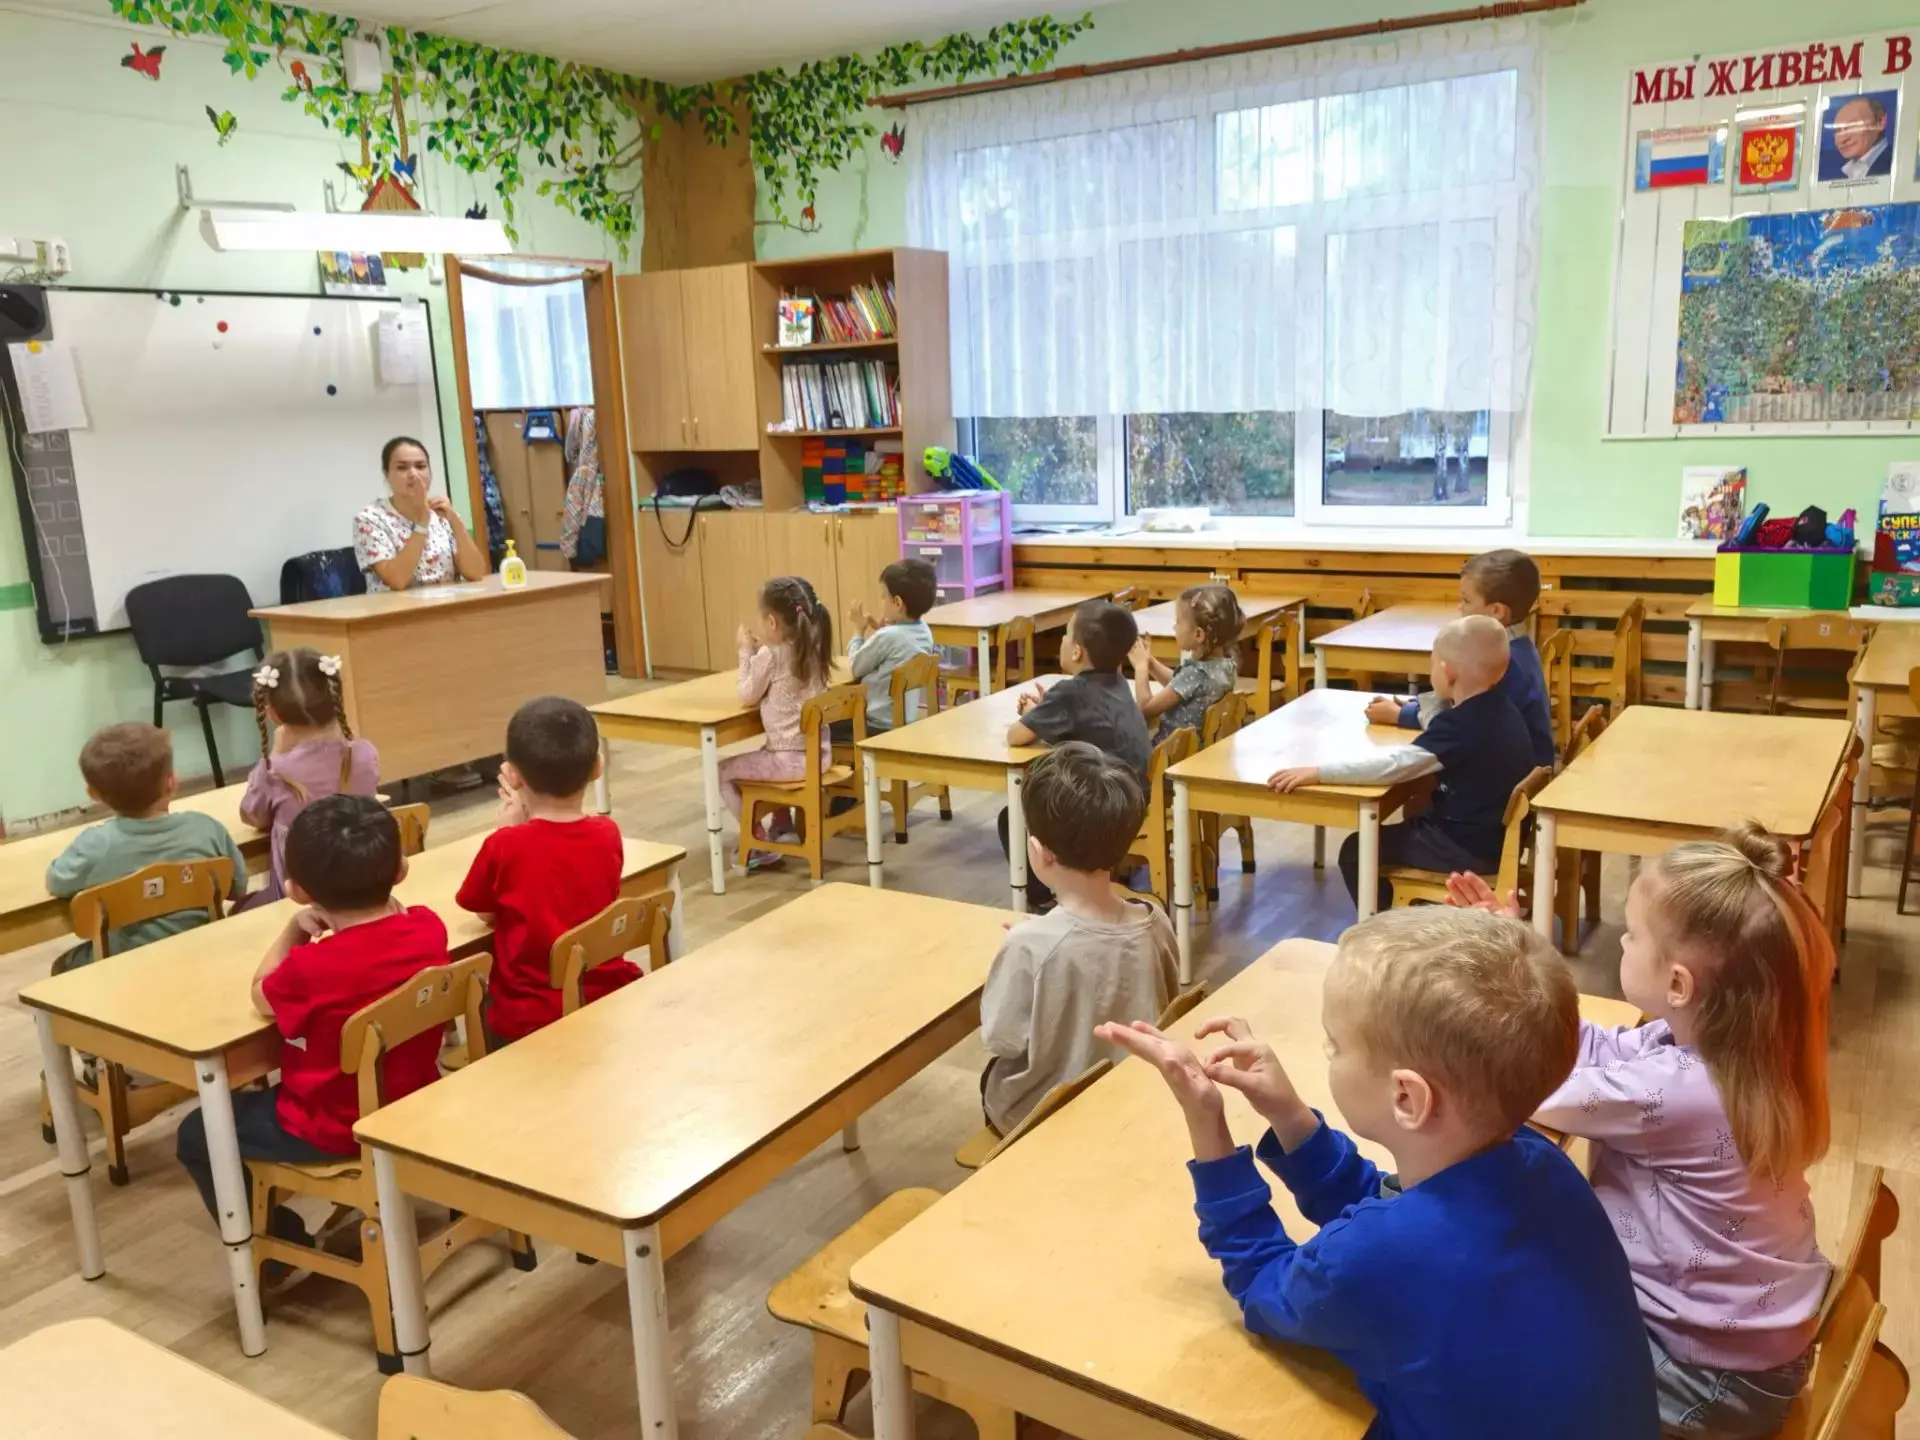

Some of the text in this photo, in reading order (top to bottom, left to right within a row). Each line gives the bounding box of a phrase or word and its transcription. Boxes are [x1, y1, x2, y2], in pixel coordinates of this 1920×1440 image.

[1632, 36, 1913, 105] МЫ ЖИВЁМ В
[1881, 515, 1920, 530] СУПЕ
